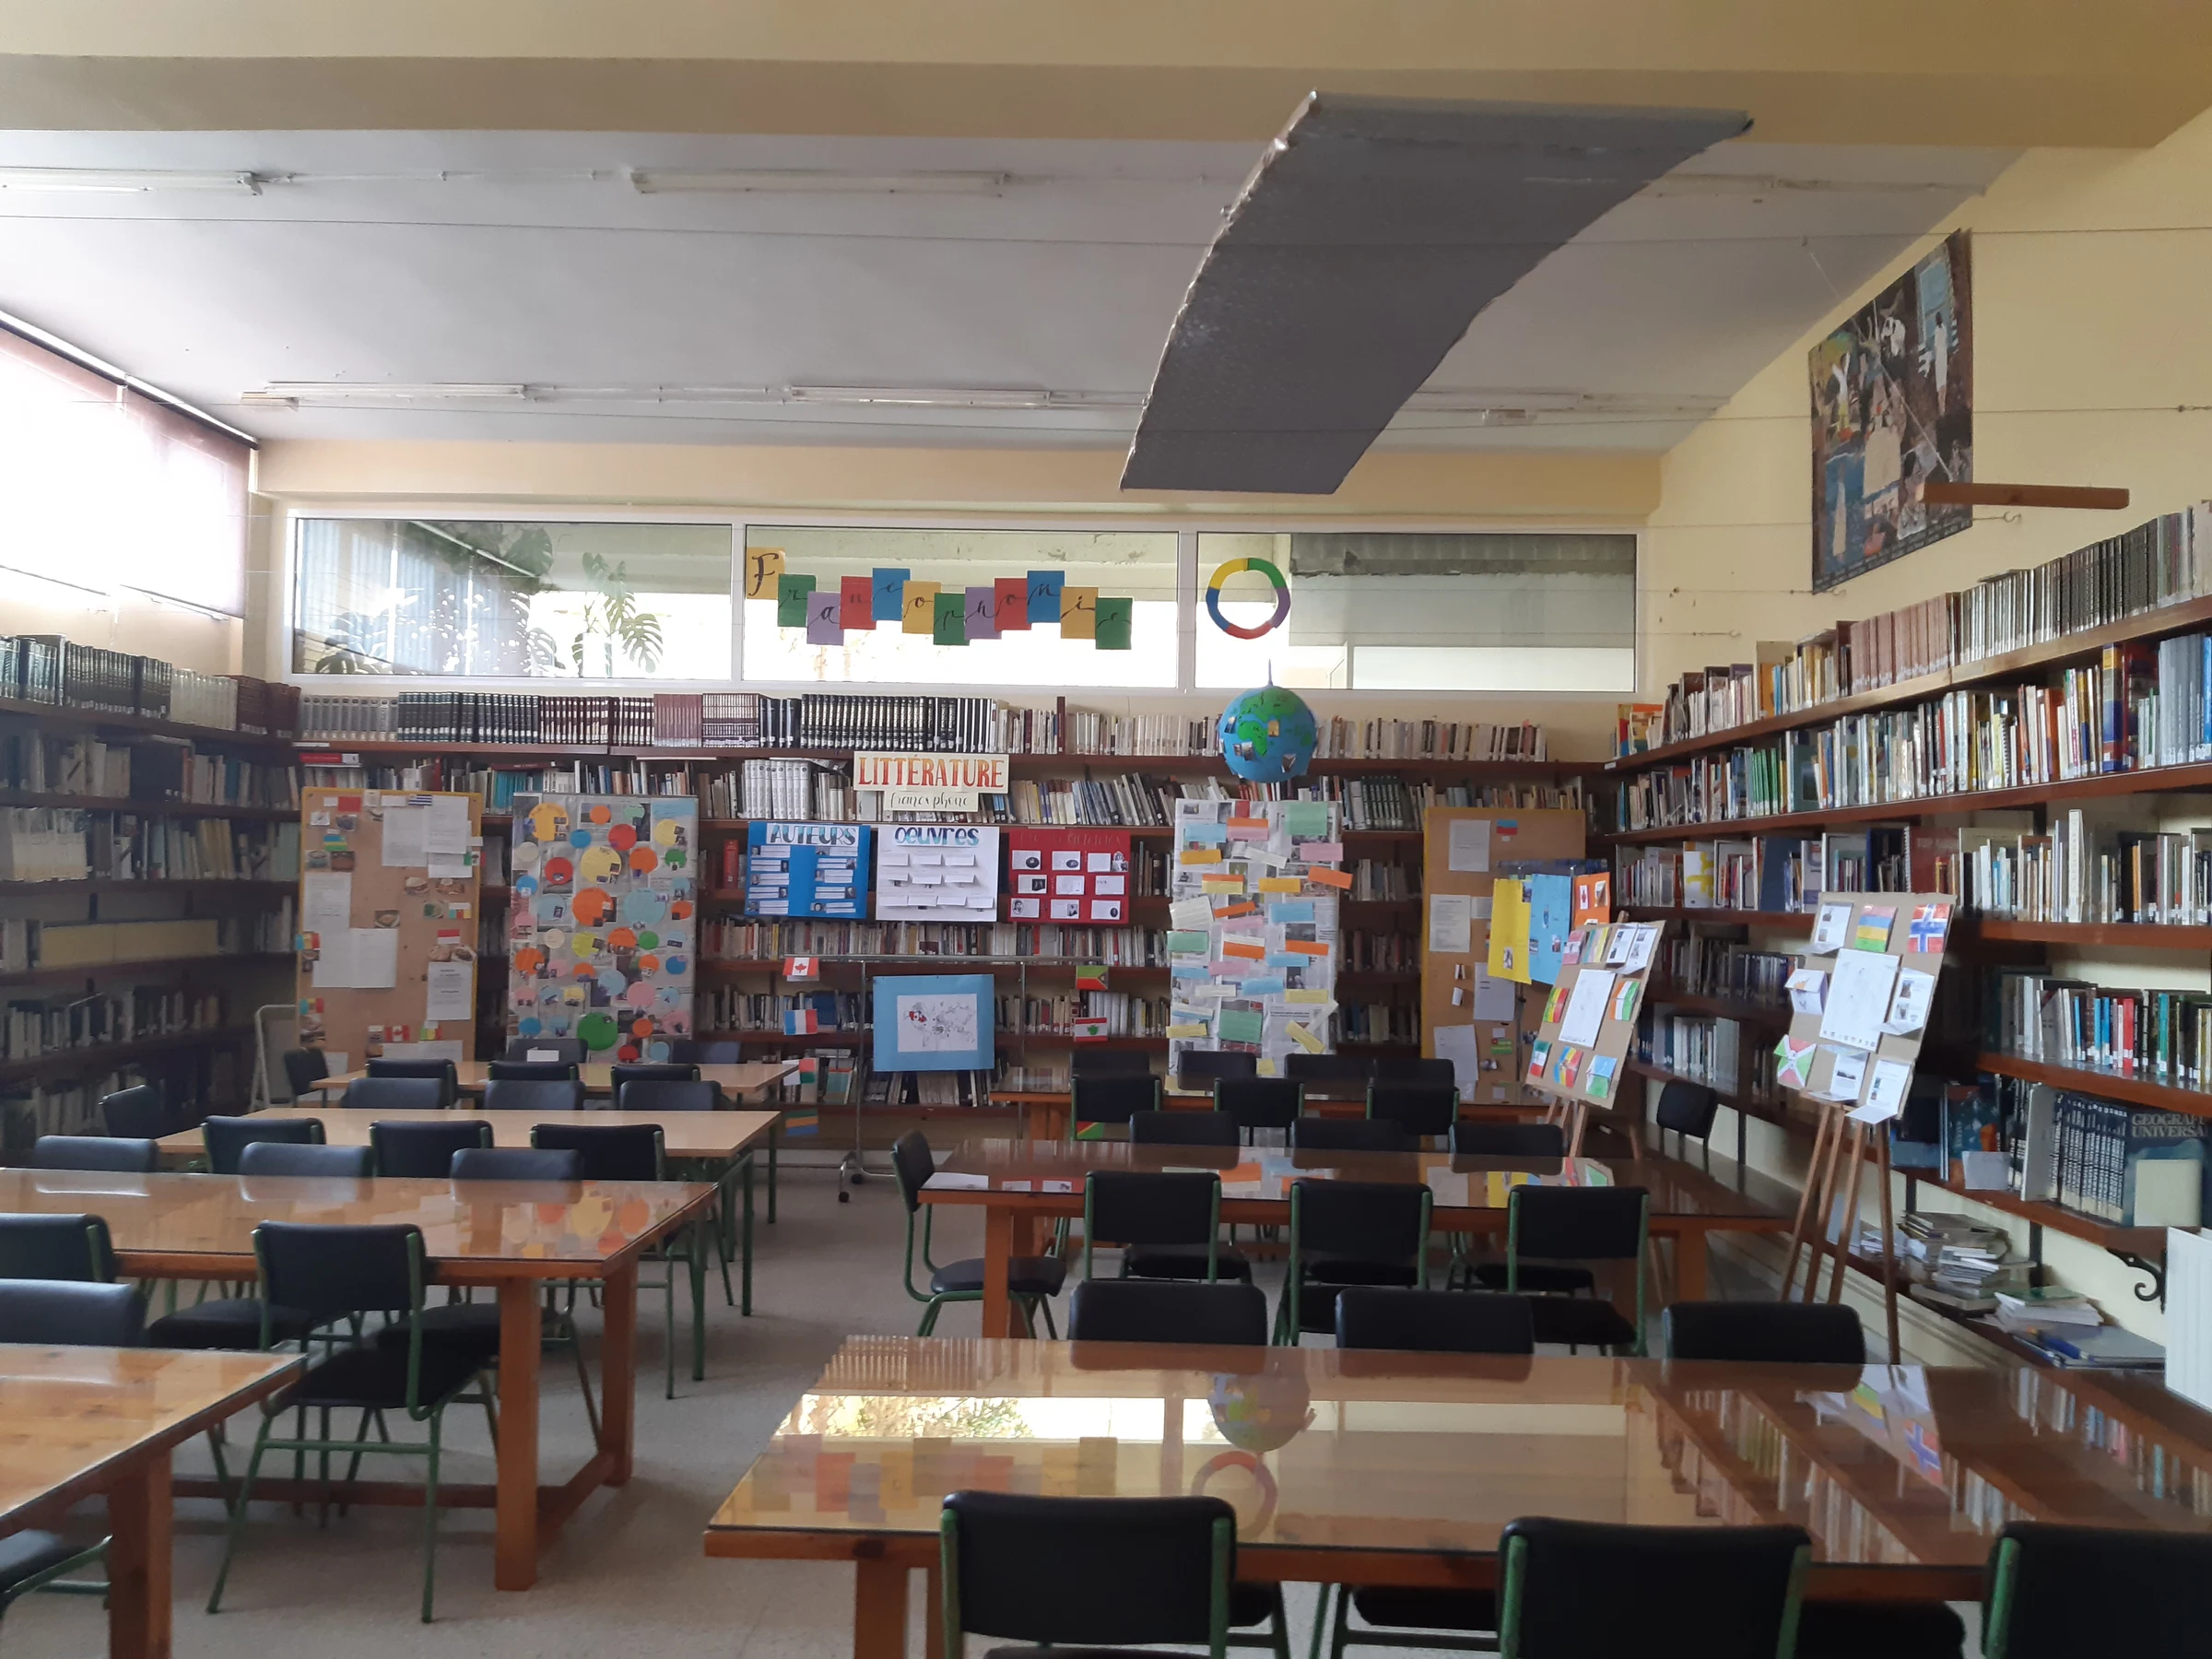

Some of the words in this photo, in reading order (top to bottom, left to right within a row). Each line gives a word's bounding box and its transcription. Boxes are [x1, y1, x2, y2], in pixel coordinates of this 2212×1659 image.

[748, 551, 1132, 631] Francophonie
[858, 754, 1005, 788] LITTÉRATURE
[890, 792, 971, 809] francophone
[770, 825, 856, 846] AUTEURS
